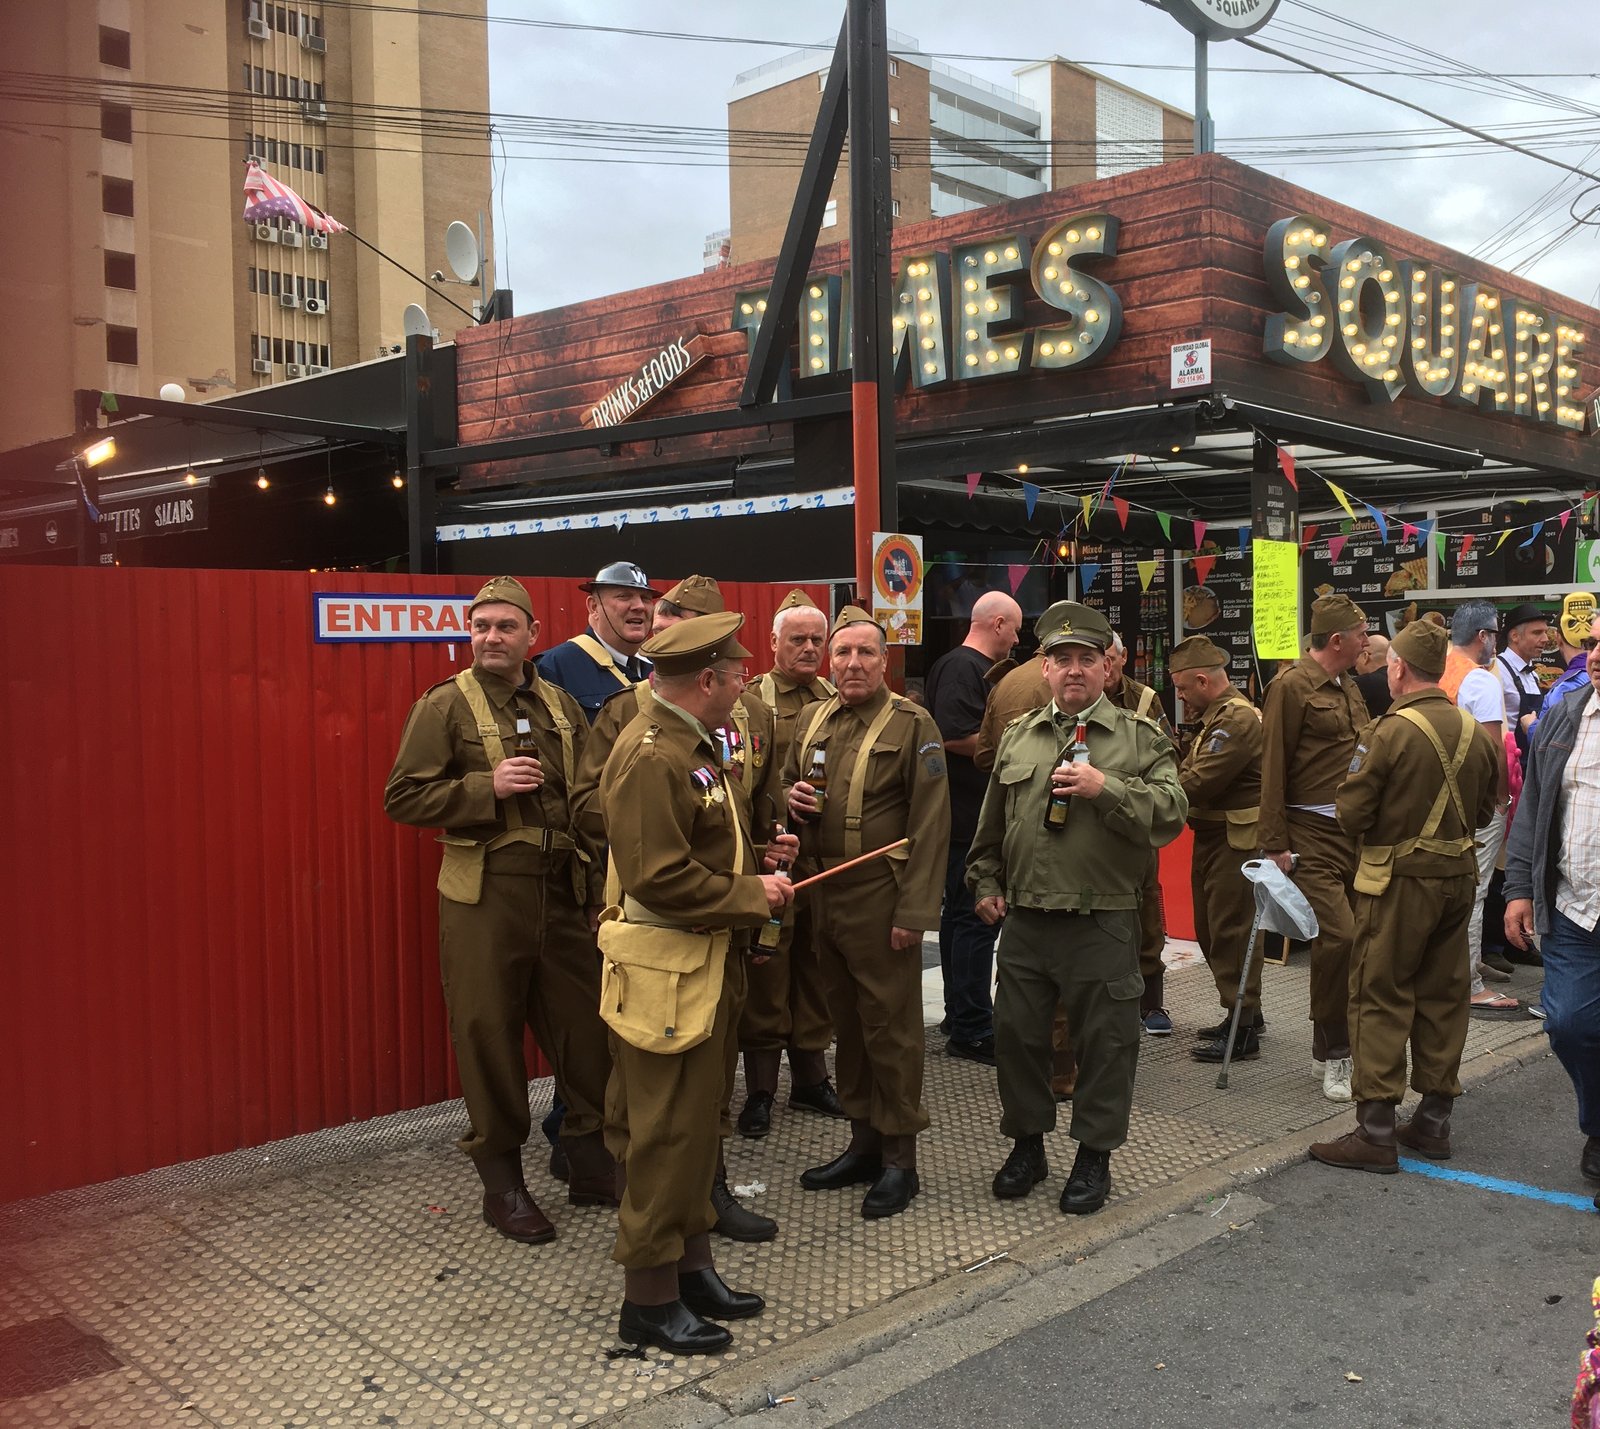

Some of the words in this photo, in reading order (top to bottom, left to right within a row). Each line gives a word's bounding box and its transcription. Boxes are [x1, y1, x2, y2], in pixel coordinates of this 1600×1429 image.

[1216, 0, 1260, 17] SQUARE
[1263, 214, 1587, 431] SQUARE
[1179, 367, 1204, 376] ALARMA
[155, 499, 194, 527] SALADS
[1340, 519, 1391, 531] ndwics
[1082, 545, 1103, 554] Mixed
[1083, 597, 1104, 607] Ciders
